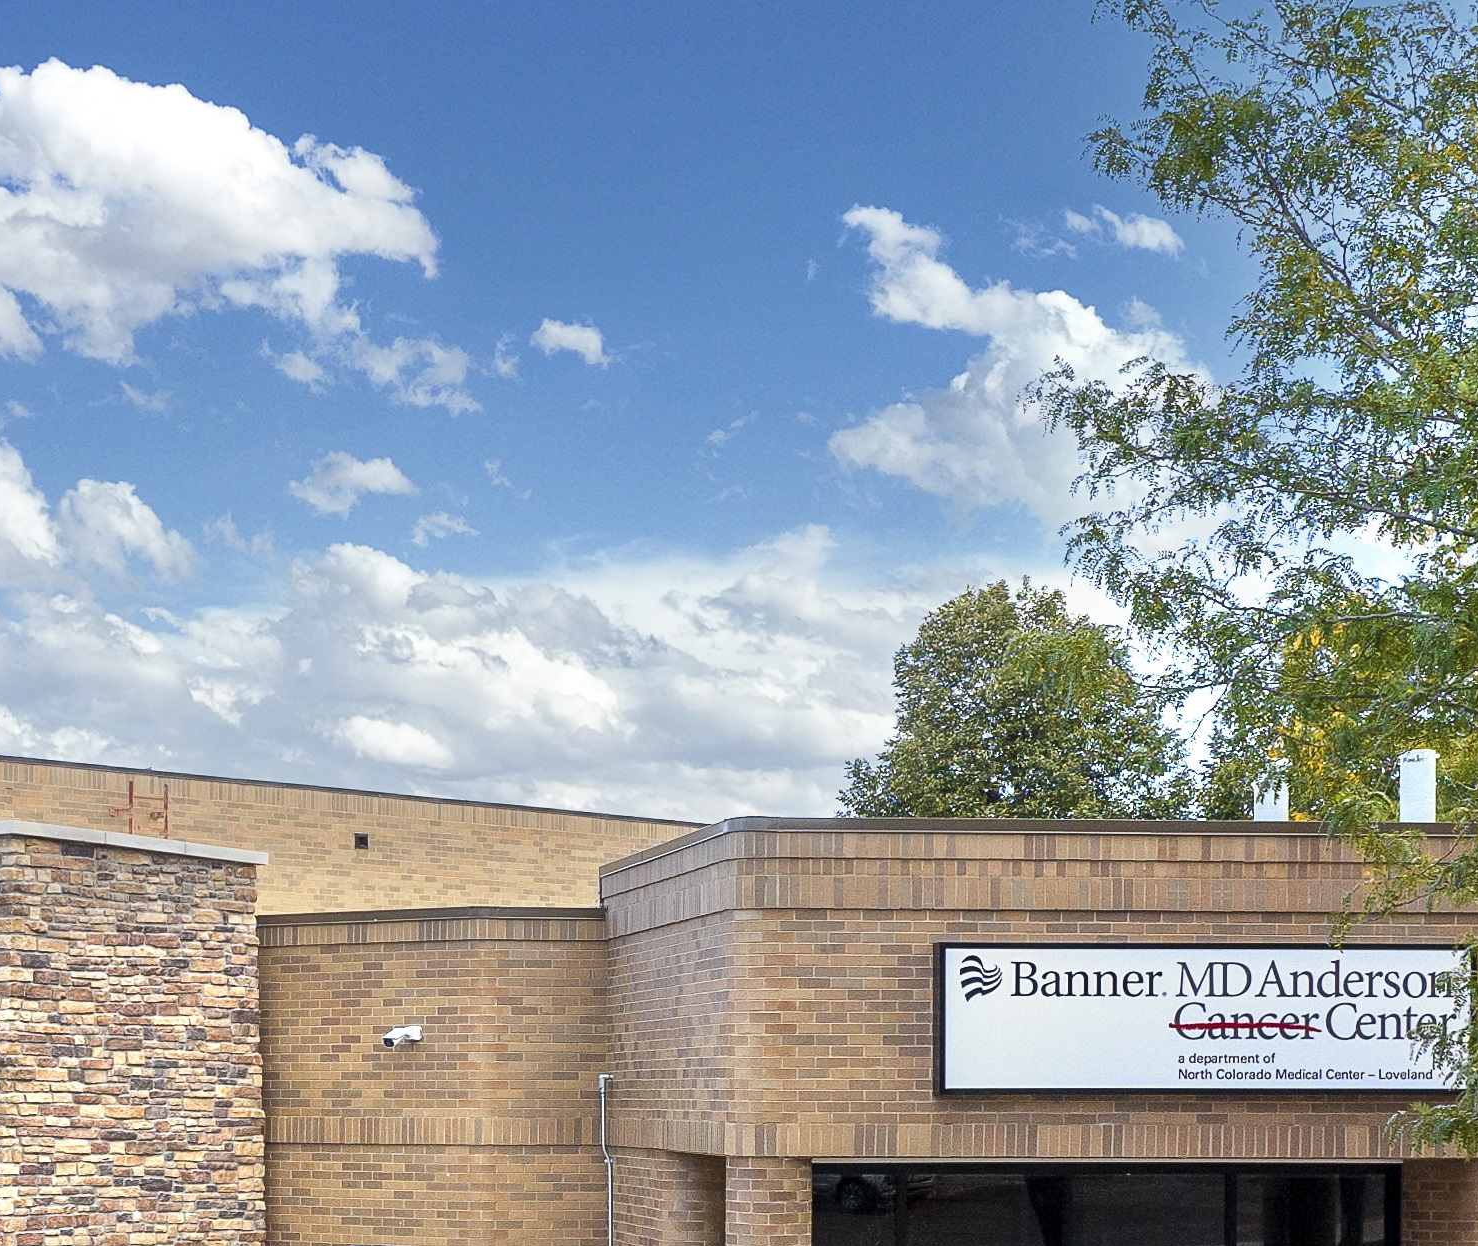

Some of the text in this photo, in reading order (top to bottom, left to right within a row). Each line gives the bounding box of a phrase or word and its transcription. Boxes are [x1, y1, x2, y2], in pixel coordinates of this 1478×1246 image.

[1010, 959, 1455, 998] Banner MD Anderson
[1174, 1002, 1456, 1040] Cancer Center
[1178, 1052, 1276, 1066] a department of
[1178, 1068, 1212, 1080] North
[1216, 1068, 1272, 1080] Colorado
[1275, 1068, 1322, 1080] Medical
[1325, 1068, 1365, 1080] Center
[1378, 1068, 1433, 1080] Loveland
